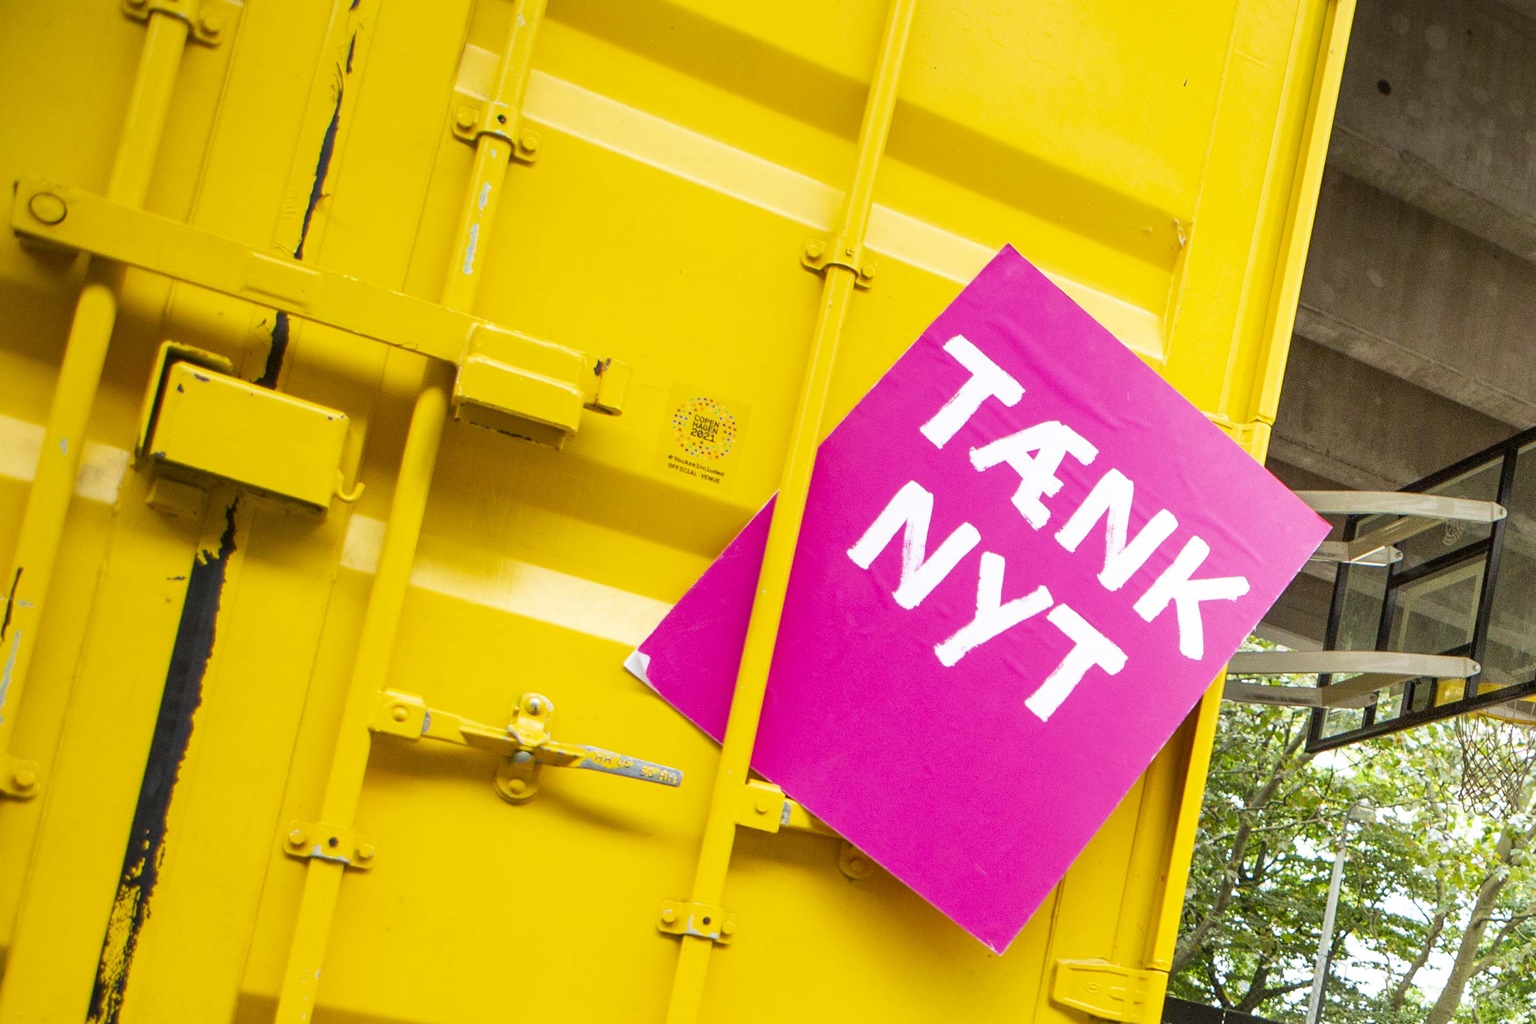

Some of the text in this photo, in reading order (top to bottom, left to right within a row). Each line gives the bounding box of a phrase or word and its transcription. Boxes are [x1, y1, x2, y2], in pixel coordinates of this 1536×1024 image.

[692, 421, 719, 435] HAGEN
[694, 414, 720, 428] COPEN
[690, 428, 716, 443] 2021
[667, 462, 720, 484] OFFICIAL VENUE
[919, 334, 1250, 661] TÆNK
[846, 480, 1128, 723] NYT
